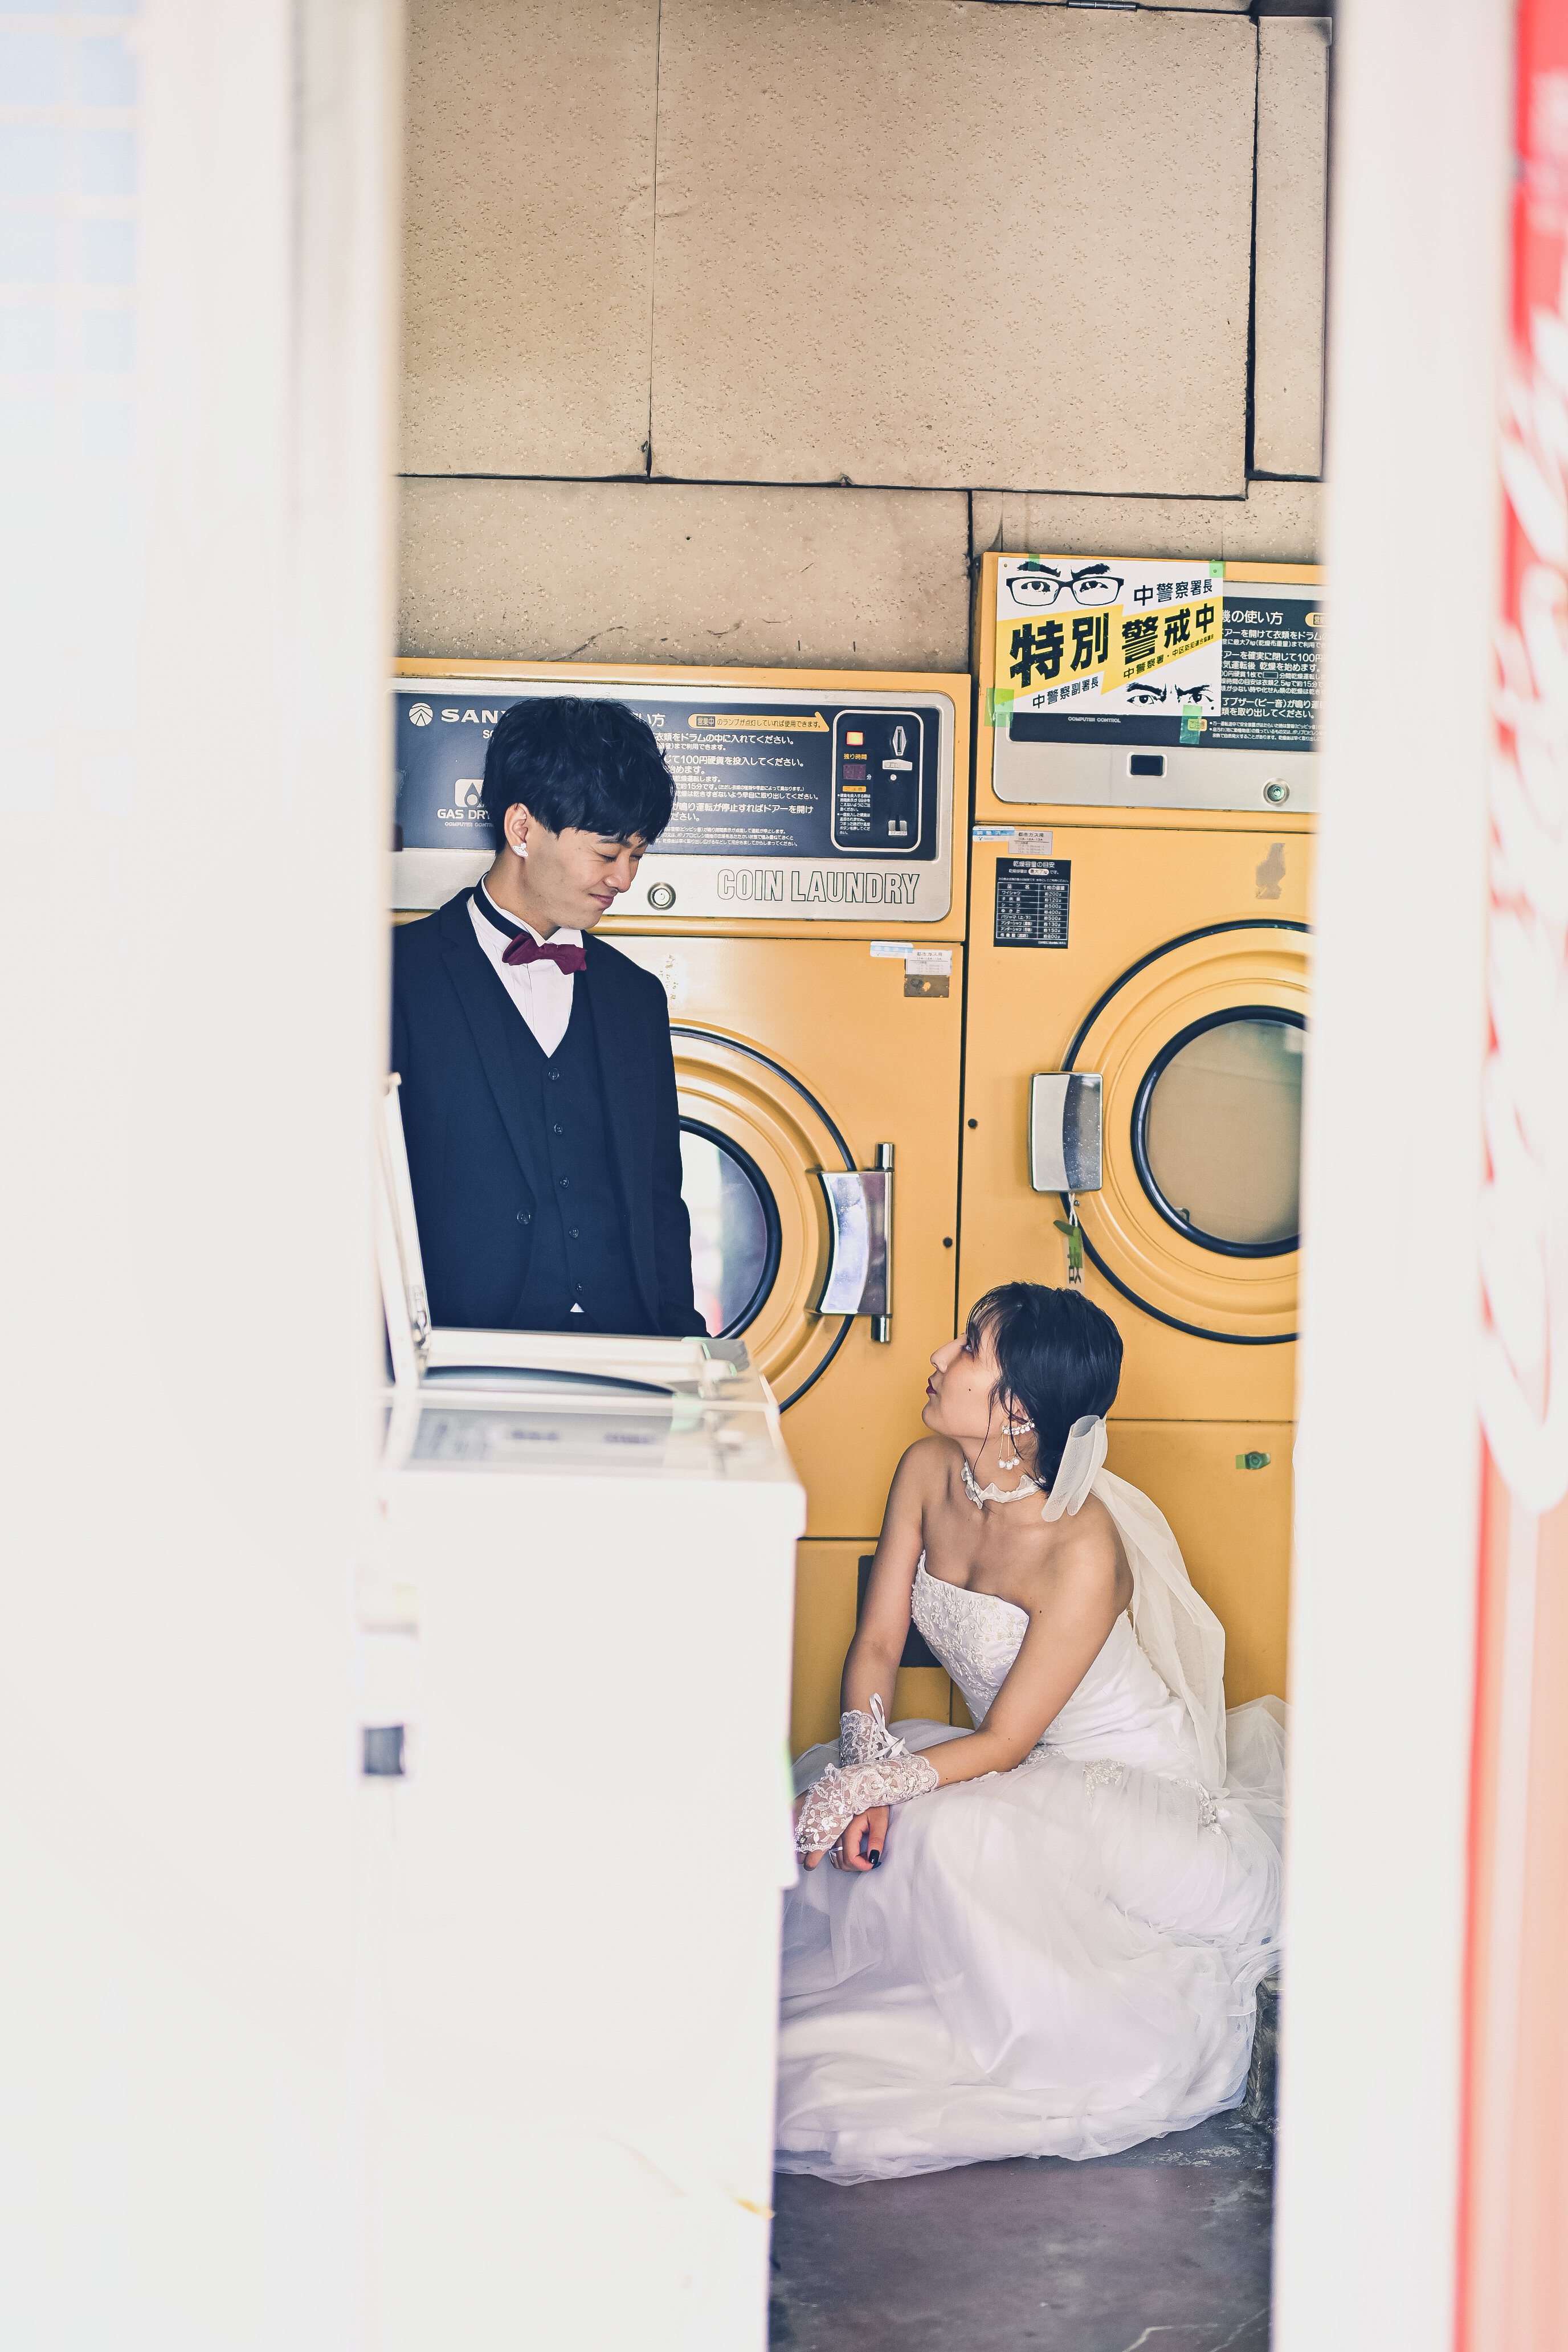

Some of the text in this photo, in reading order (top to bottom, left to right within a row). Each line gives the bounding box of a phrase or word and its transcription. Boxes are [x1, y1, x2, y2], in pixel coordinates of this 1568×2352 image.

[1134, 579, 1212, 606] 中警察署長
[1010, 603, 1214, 688] 特別 警戒中
[1221, 660, 1256, 669] 気運転後
[1032, 676, 1099, 709] 中警察副署長
[441, 709, 506, 724] SAN
[633, 712, 666, 728] い方
[437, 808, 464, 819] GAS
[717, 869, 920, 904] COIN LAUNDRY
